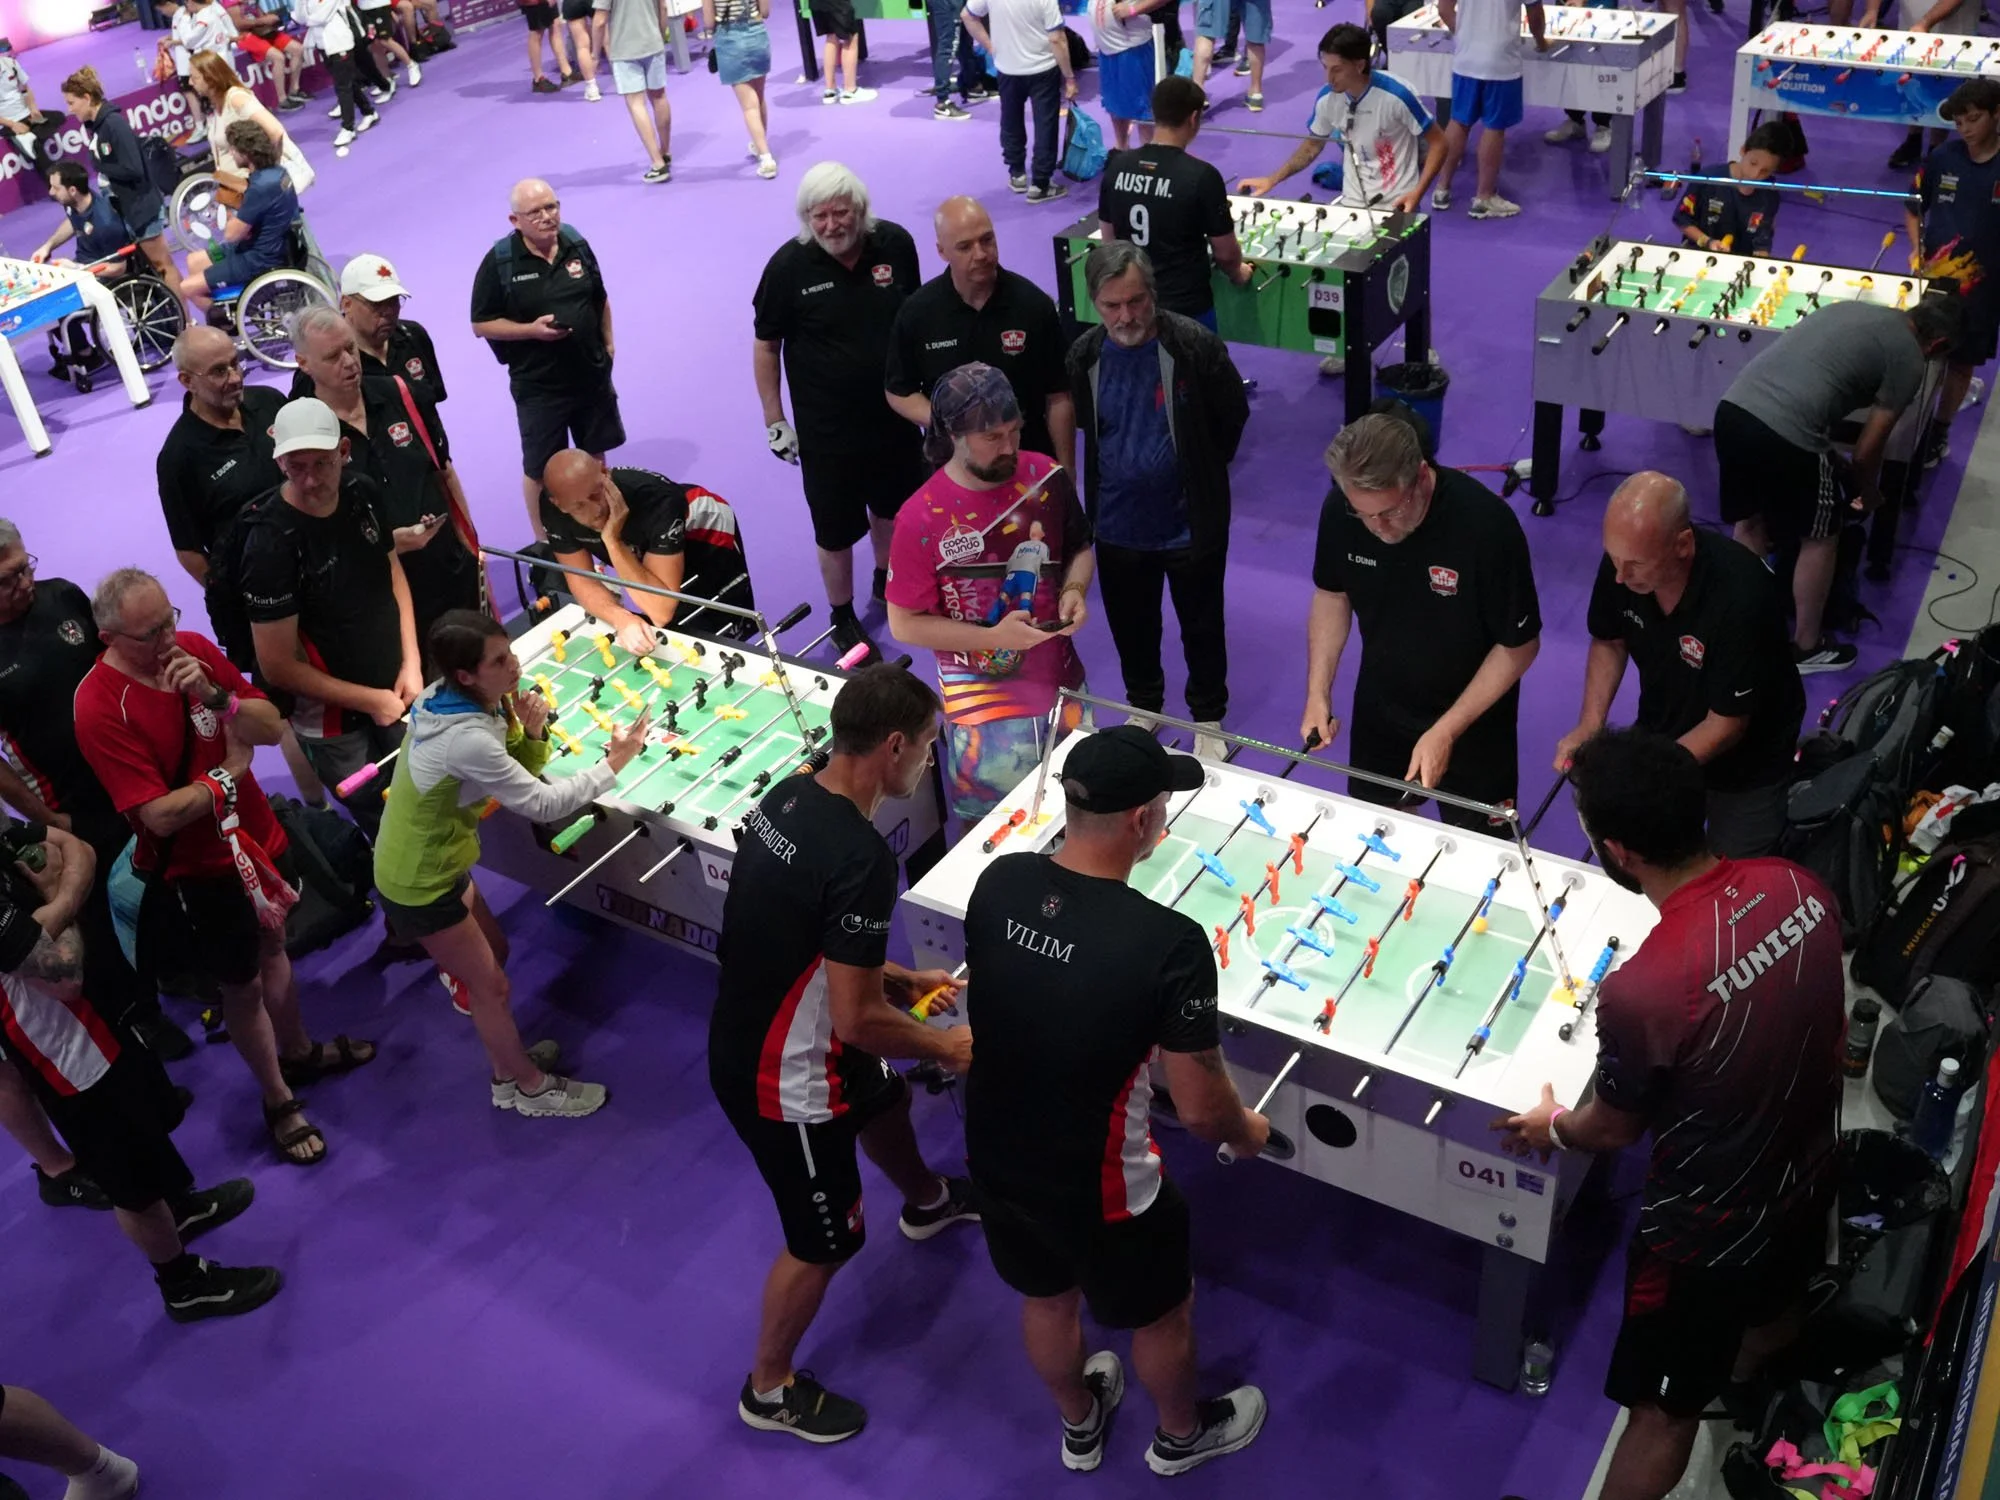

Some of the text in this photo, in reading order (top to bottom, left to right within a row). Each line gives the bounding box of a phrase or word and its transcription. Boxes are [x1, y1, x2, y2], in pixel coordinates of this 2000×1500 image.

[1114, 171, 1173, 198] AUST M.
[1129, 203, 1150, 247] 9
[1314, 288, 1340, 304] 039
[931, 338, 958, 350] DUMONT
[956, 578, 983, 621] PAIN
[750, 806, 797, 865] OFBAUER
[707, 863, 730, 881] 04
[596, 884, 721, 954] TORNADO
[1007, 918, 1075, 963] VILIM
[1706, 895, 1826, 1004] TUNISIA
[1458, 1160, 1505, 1188] 041
[1944, 1281, 1996, 1474] INTERNATIONAL
